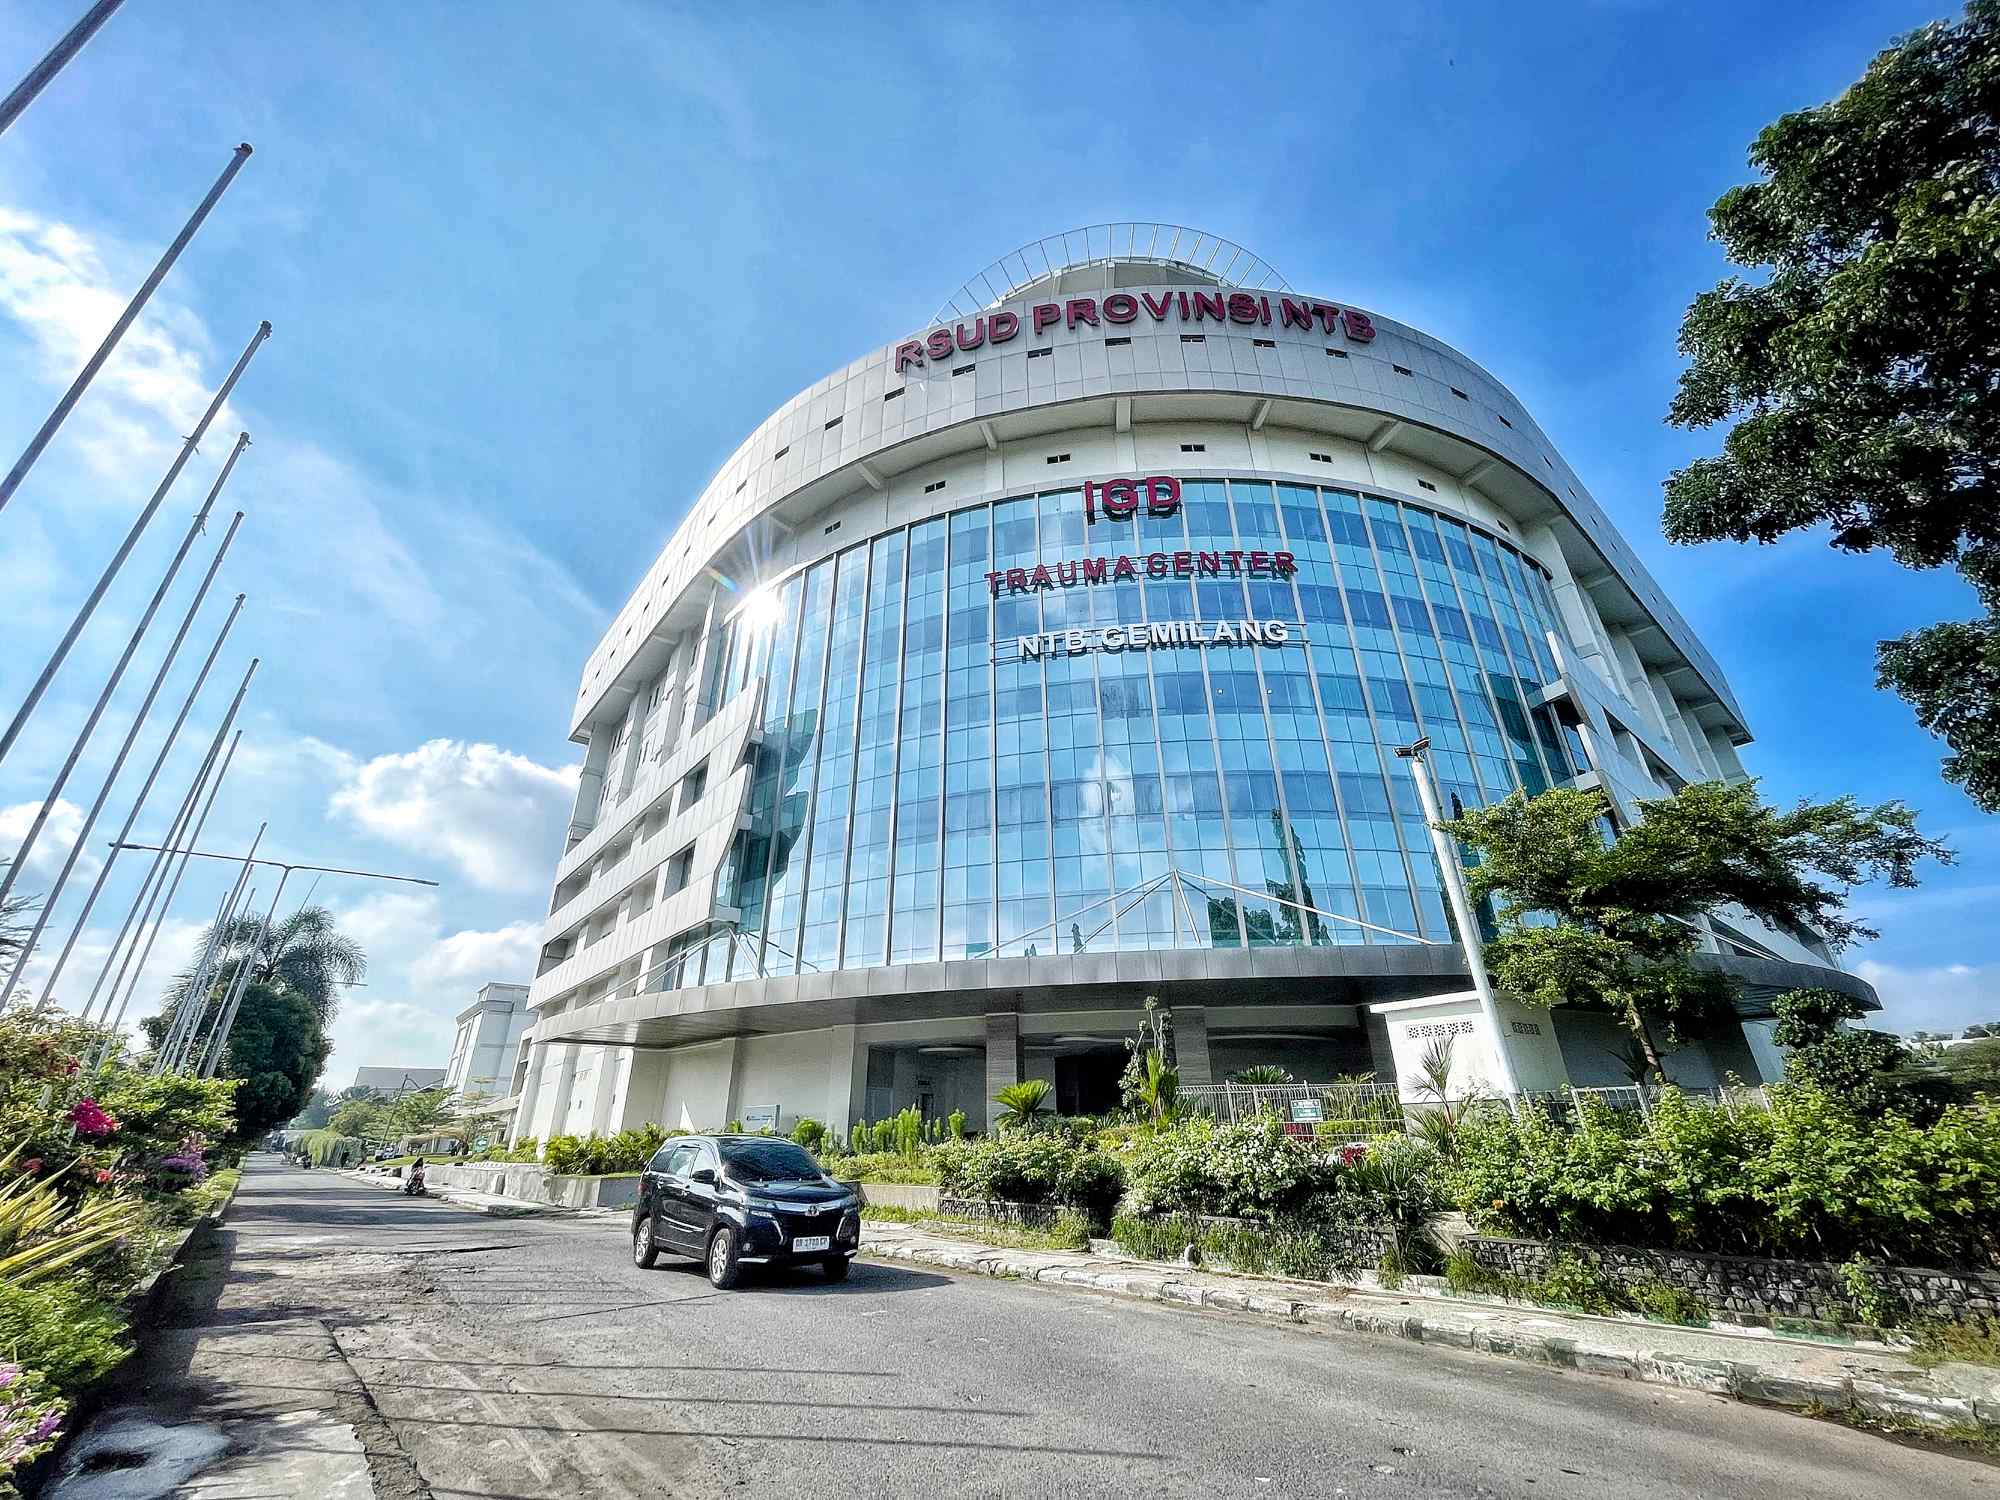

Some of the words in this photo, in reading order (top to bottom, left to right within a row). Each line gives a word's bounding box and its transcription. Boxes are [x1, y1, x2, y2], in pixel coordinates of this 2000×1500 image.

[895, 311, 1020, 373] RSUD
[1033, 291, 1272, 336] PROVINSI
[1280, 298, 1377, 343] NTB
[1084, 476, 1181, 516] IGD
[984, 555, 1136, 593] TRAUMA
[1148, 551, 1299, 574] CENTER
[1018, 628, 1087, 657] NTB
[1102, 620, 1288, 647] GEMILANG
